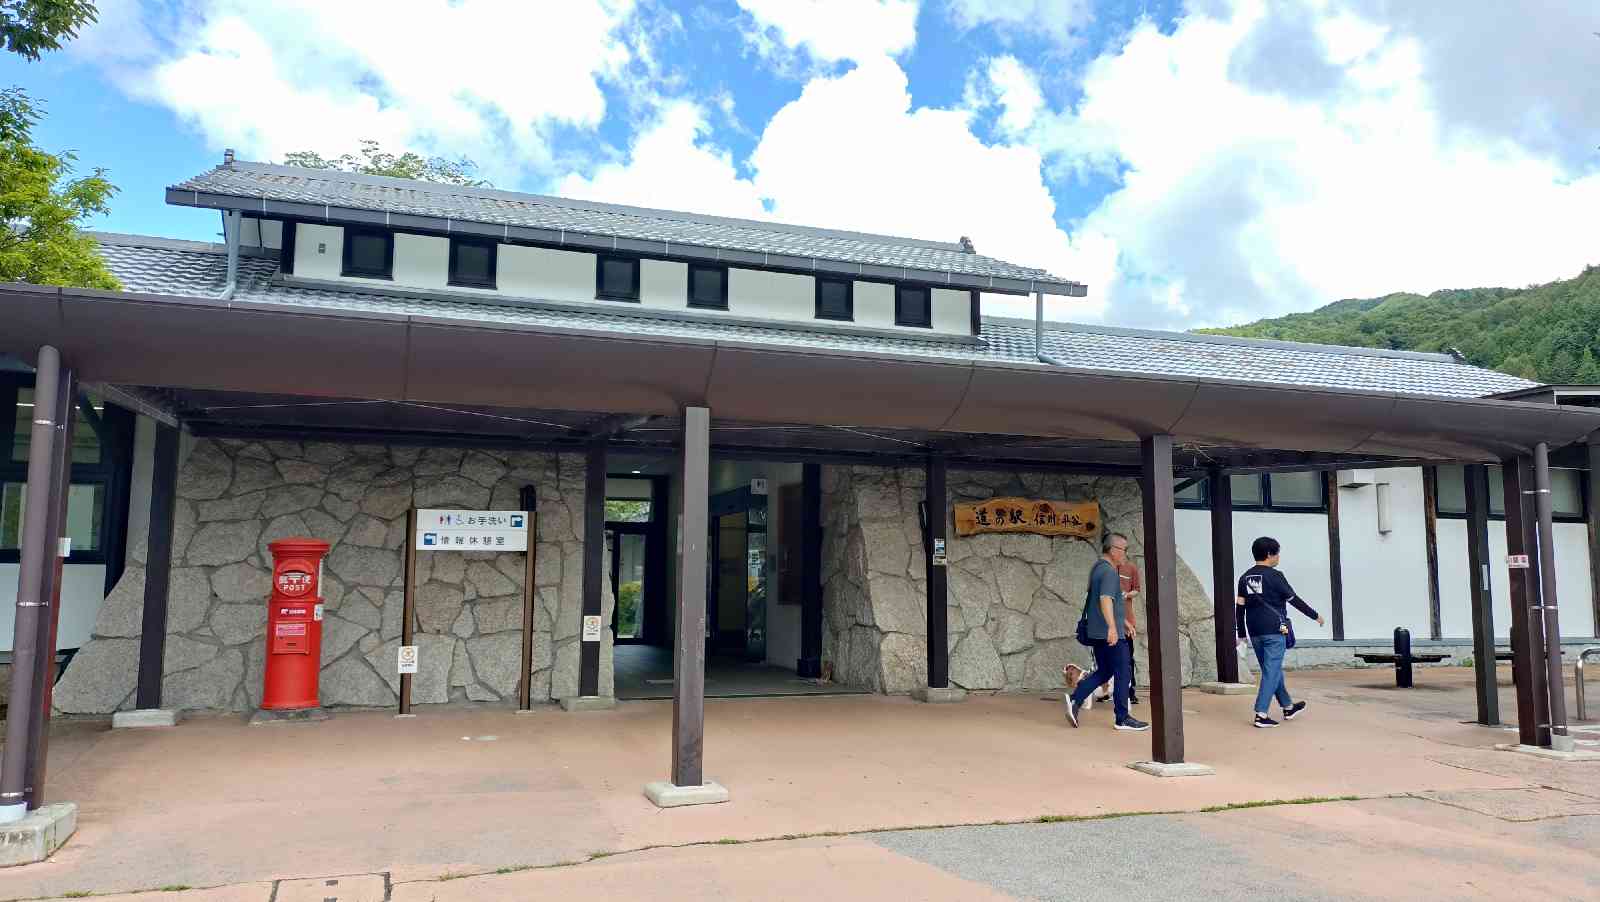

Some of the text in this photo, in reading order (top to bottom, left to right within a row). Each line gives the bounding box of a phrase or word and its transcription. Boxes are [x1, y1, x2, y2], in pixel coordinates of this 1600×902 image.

[468, 515, 507, 526] お手洗い
[975, 507, 1027, 526] 道の駅
[441, 535, 505, 546] 情報休憩室
[283, 584, 305, 592] POST
